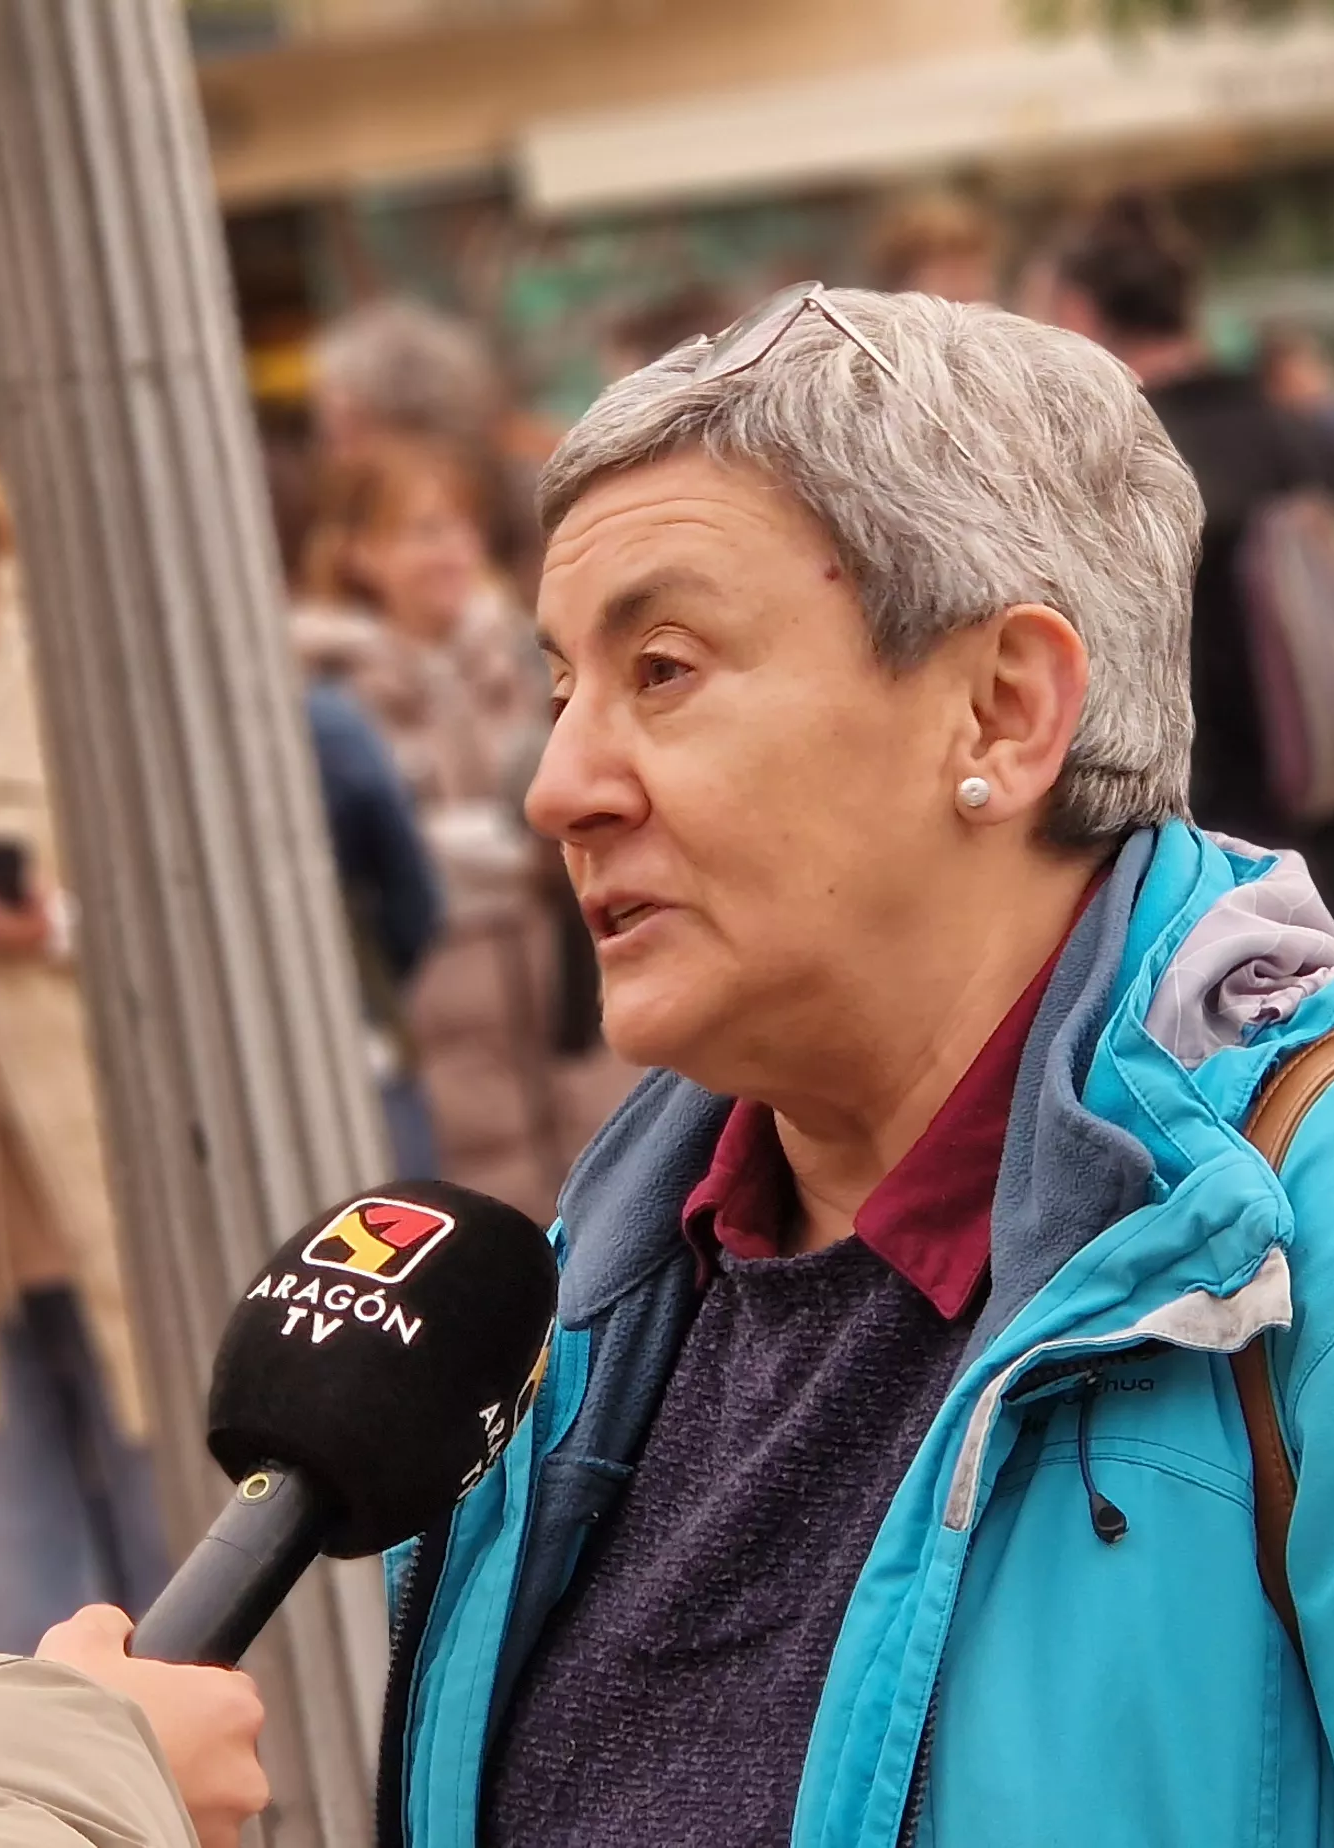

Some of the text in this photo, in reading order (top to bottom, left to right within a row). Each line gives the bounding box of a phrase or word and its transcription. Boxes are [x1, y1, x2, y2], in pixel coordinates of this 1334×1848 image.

[246, 1273, 423, 1345] ARAGÓN
[280, 1305, 344, 1344] TV
[478, 1401, 507, 1466] ARA
